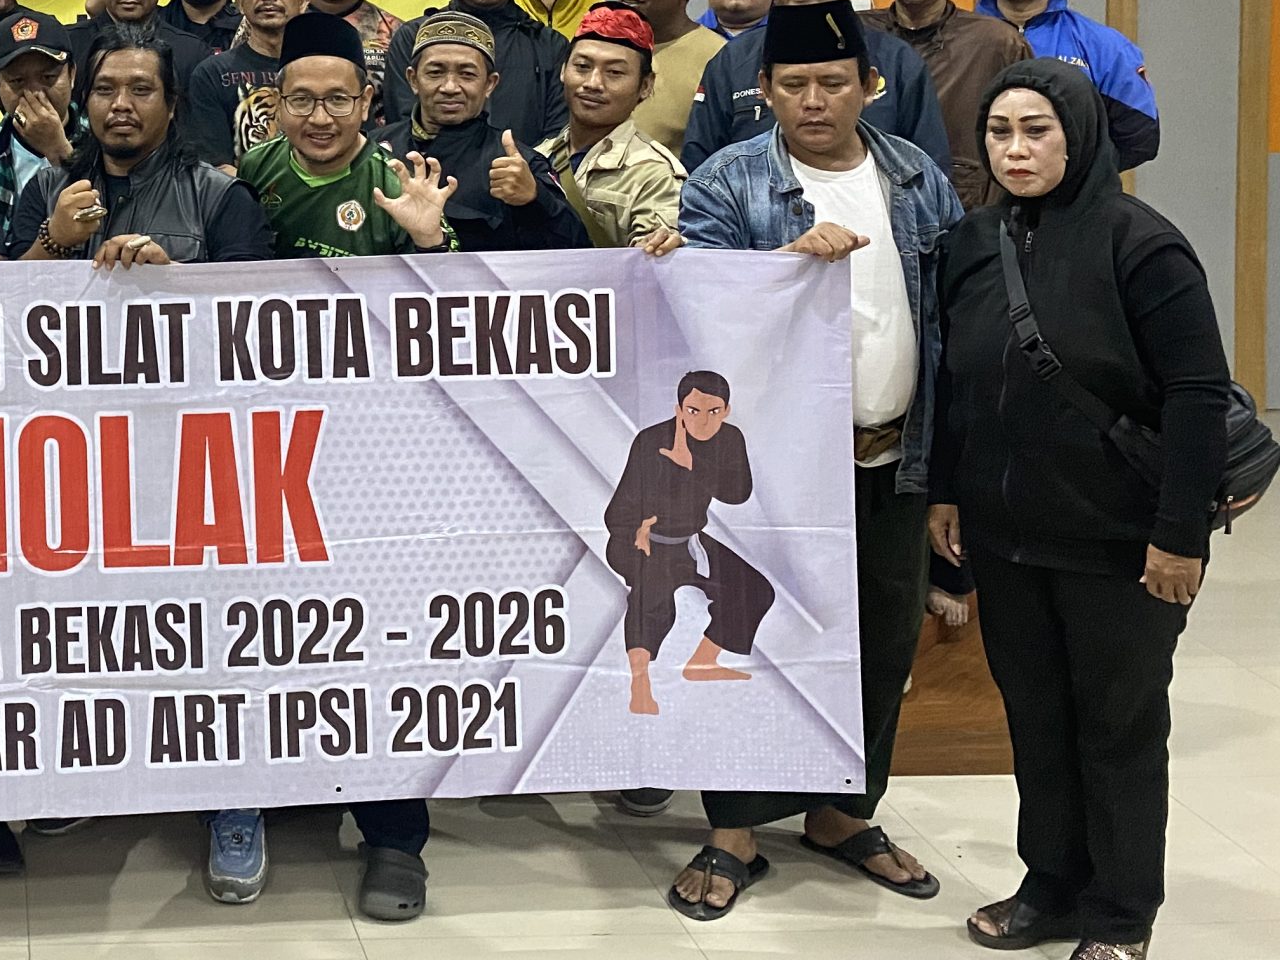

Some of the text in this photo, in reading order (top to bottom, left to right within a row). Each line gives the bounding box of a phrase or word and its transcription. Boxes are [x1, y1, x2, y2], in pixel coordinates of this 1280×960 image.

[29, 302, 191, 388] SILAT
[221, 297, 370, 382] KOTA
[396, 293, 613, 377] BEKASI
[20, 602, 205, 676] BEKASI
[226, 597, 365, 668] 2022
[428, 589, 567, 661] 2026
[60, 698, 128, 769] AD
[150, 693, 247, 764] ART
[268, 688, 369, 760] IPSI
[391, 682, 520, 754] 2021
